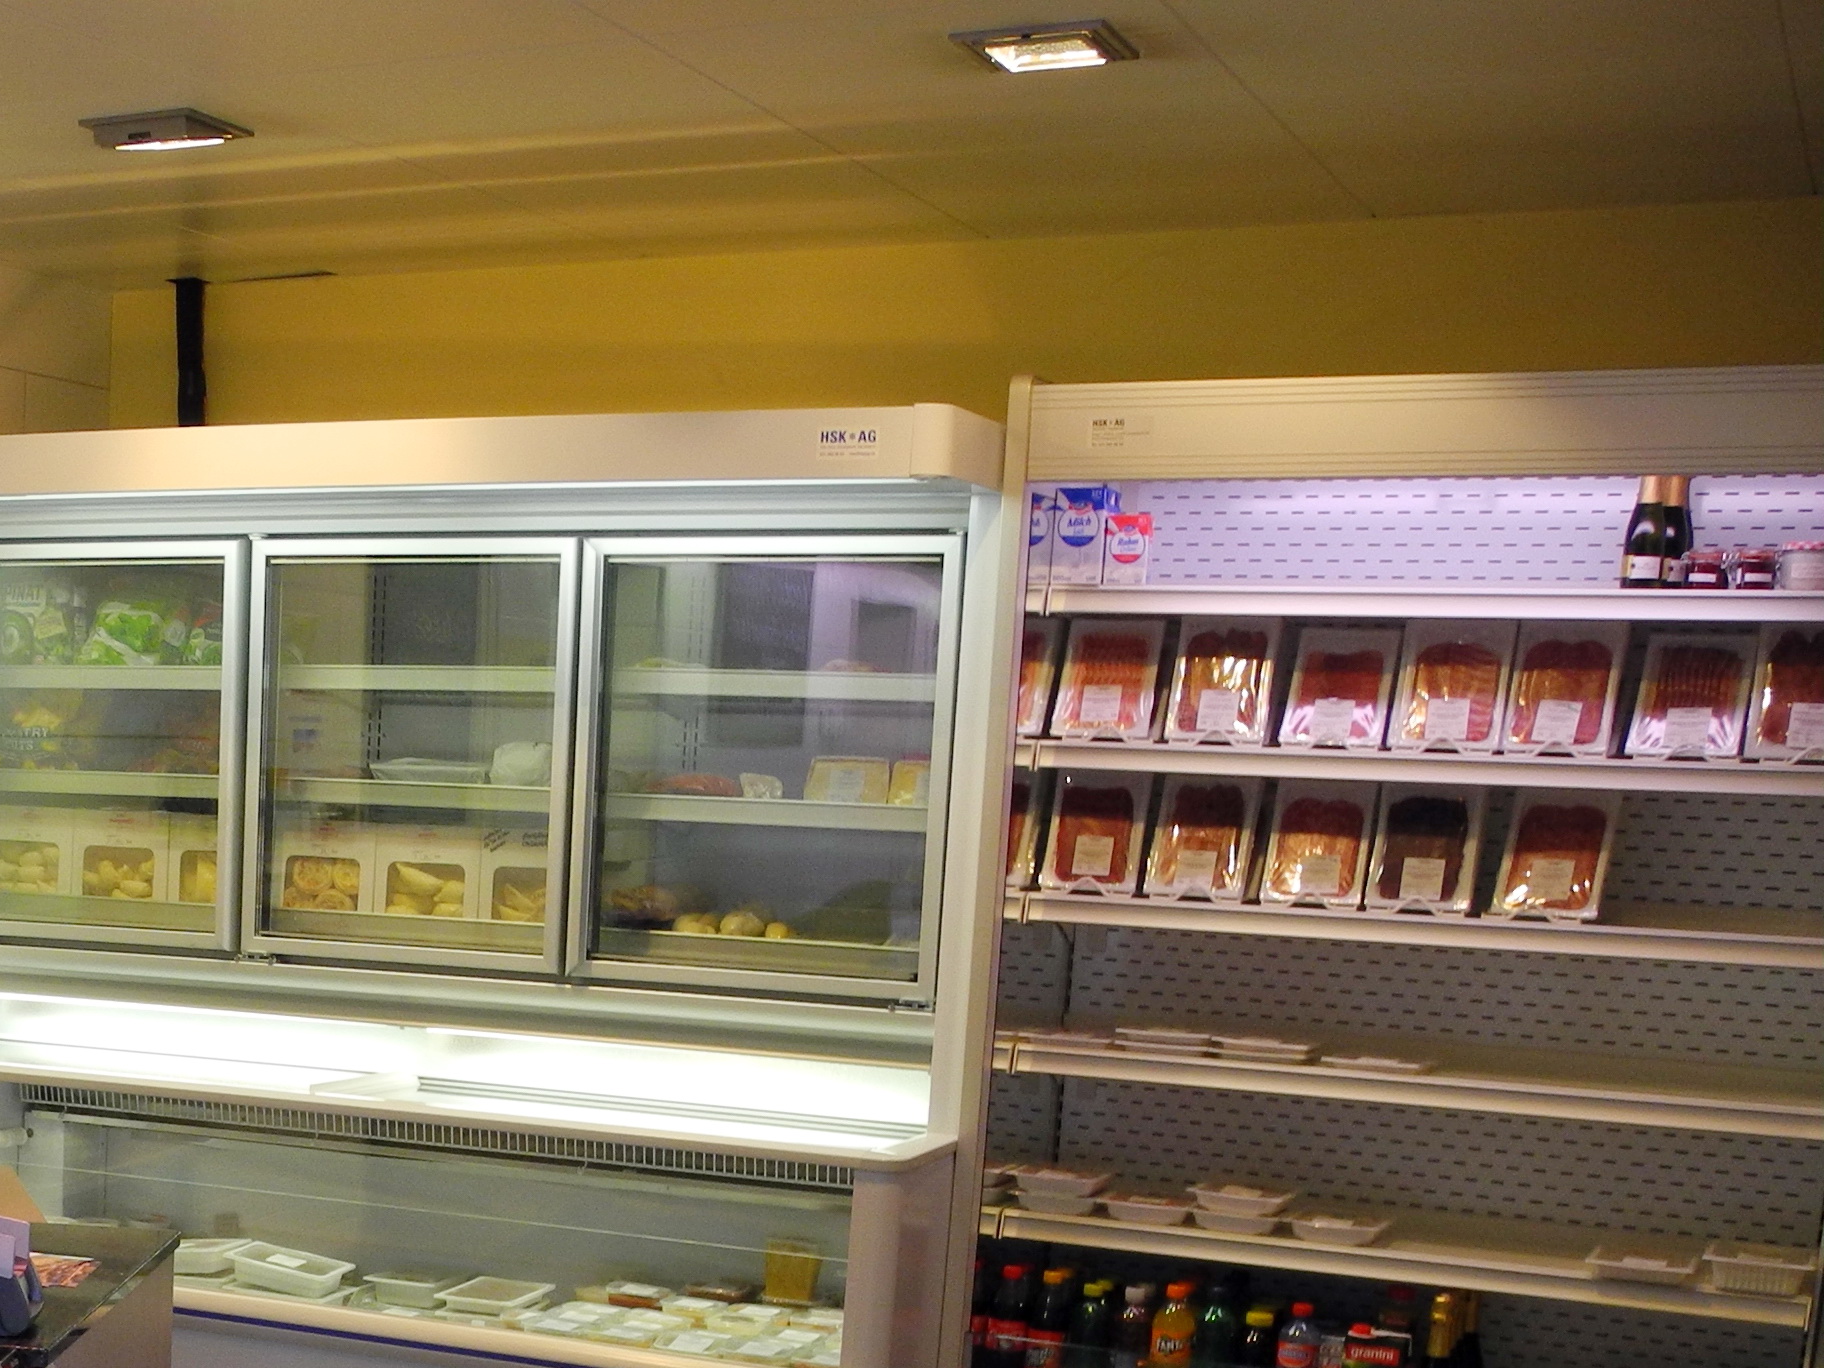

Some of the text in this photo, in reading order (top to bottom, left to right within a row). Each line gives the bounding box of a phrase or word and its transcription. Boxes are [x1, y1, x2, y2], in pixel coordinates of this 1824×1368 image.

[820, 430, 877, 443] HSK AG
[1350, 1345, 1394, 1362] granini
